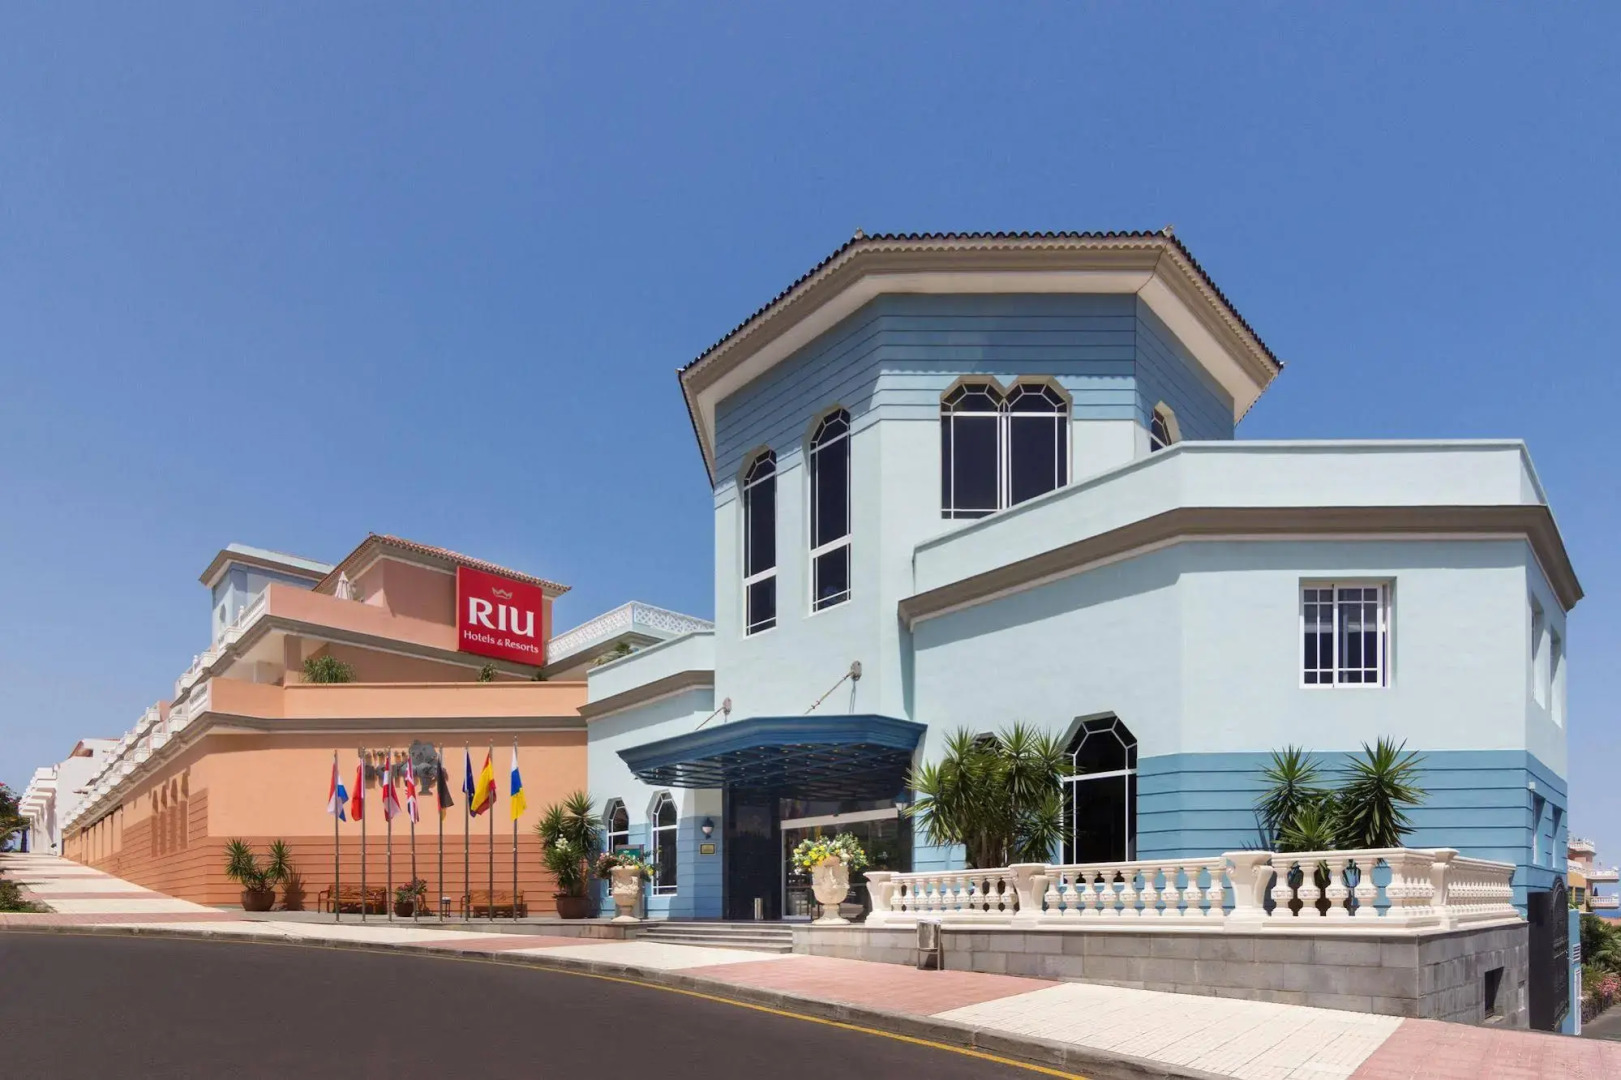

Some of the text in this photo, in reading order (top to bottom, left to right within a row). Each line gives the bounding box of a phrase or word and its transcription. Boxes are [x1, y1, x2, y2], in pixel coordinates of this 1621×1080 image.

[468, 596, 534, 638] RIU
[464, 630, 539, 654] Hotels & Resorts
